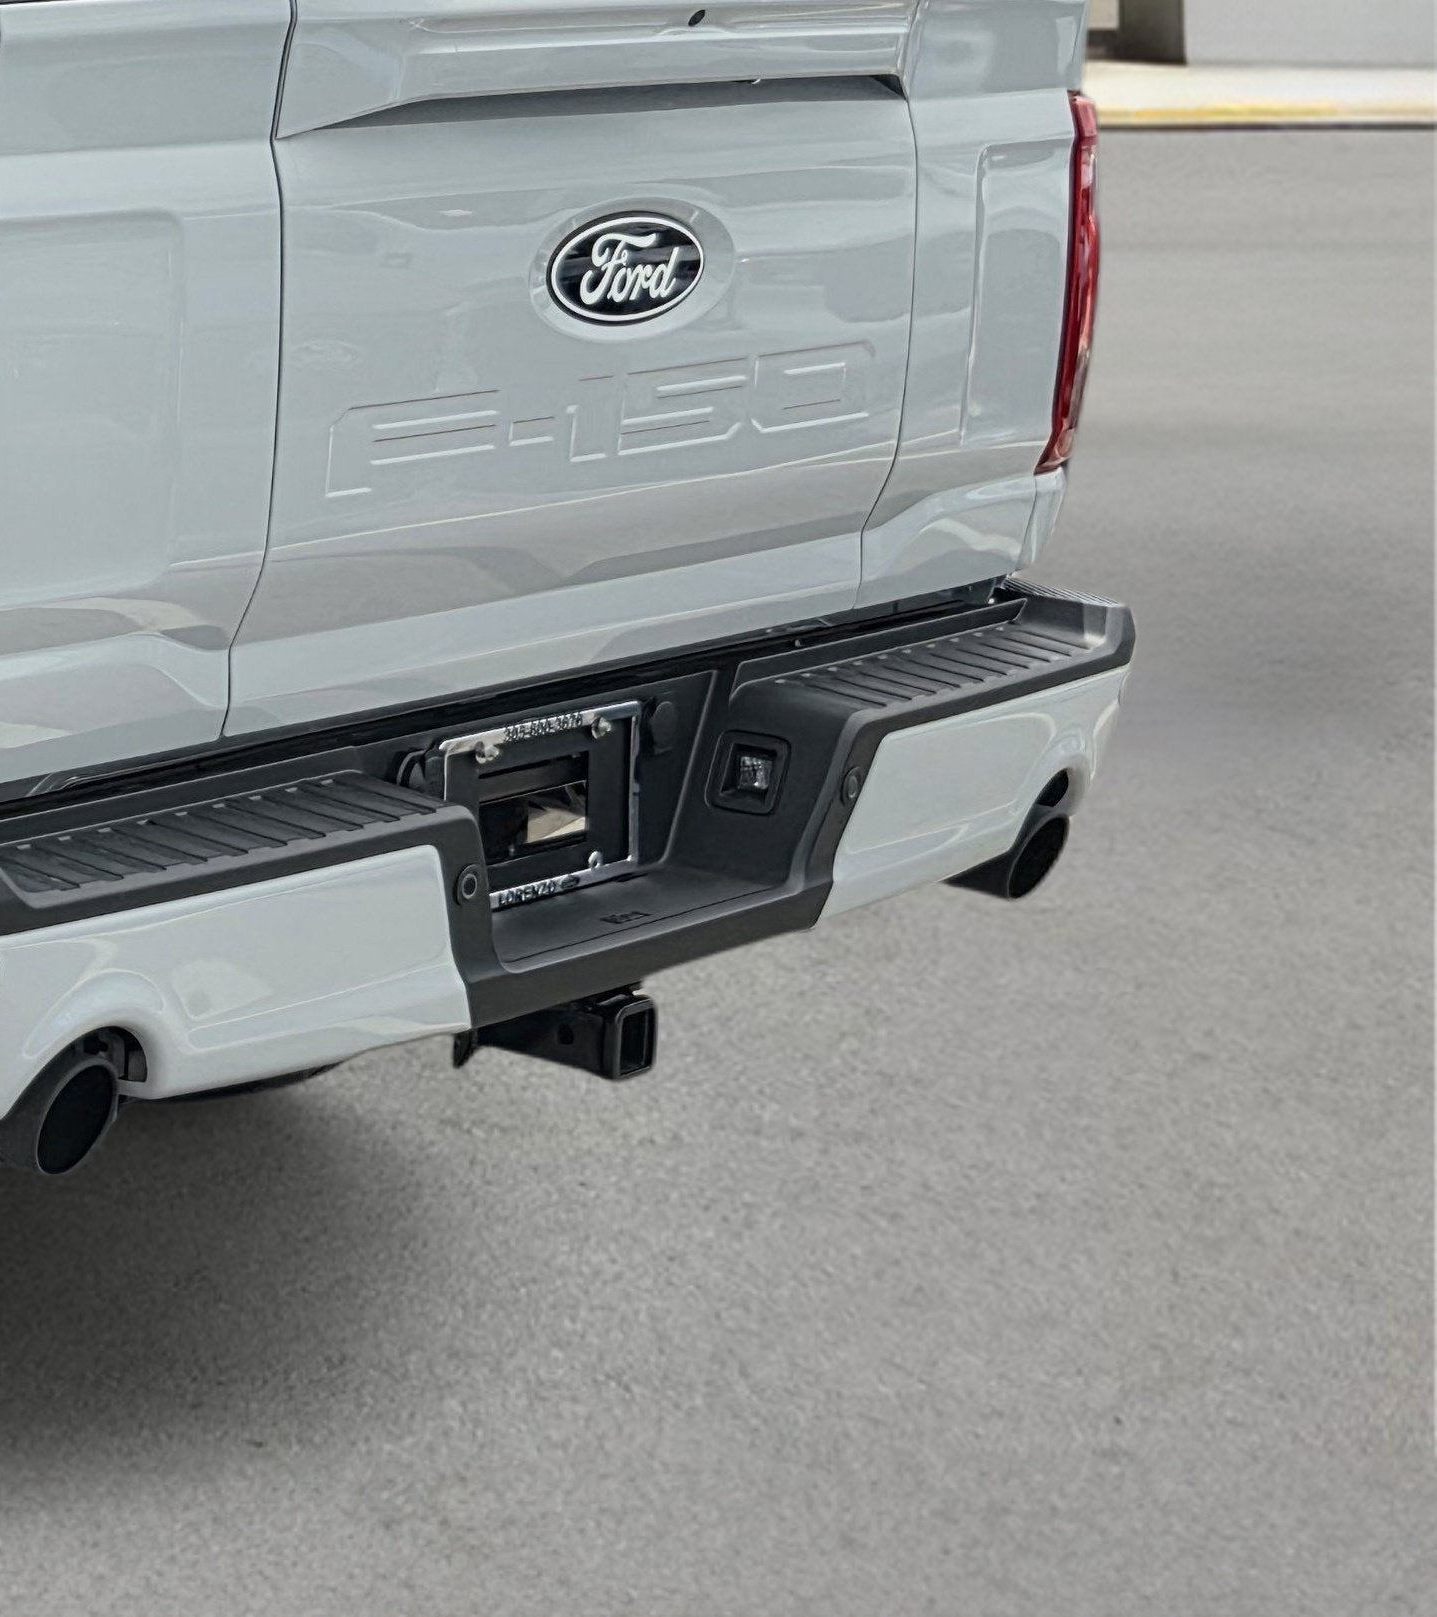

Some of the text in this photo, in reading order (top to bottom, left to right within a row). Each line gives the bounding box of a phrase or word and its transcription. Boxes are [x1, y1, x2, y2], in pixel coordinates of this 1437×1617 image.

[580, 232, 680, 304] Ford
[325, 339, 877, 498] F-150
[498, 878, 556, 906] LORENZO
